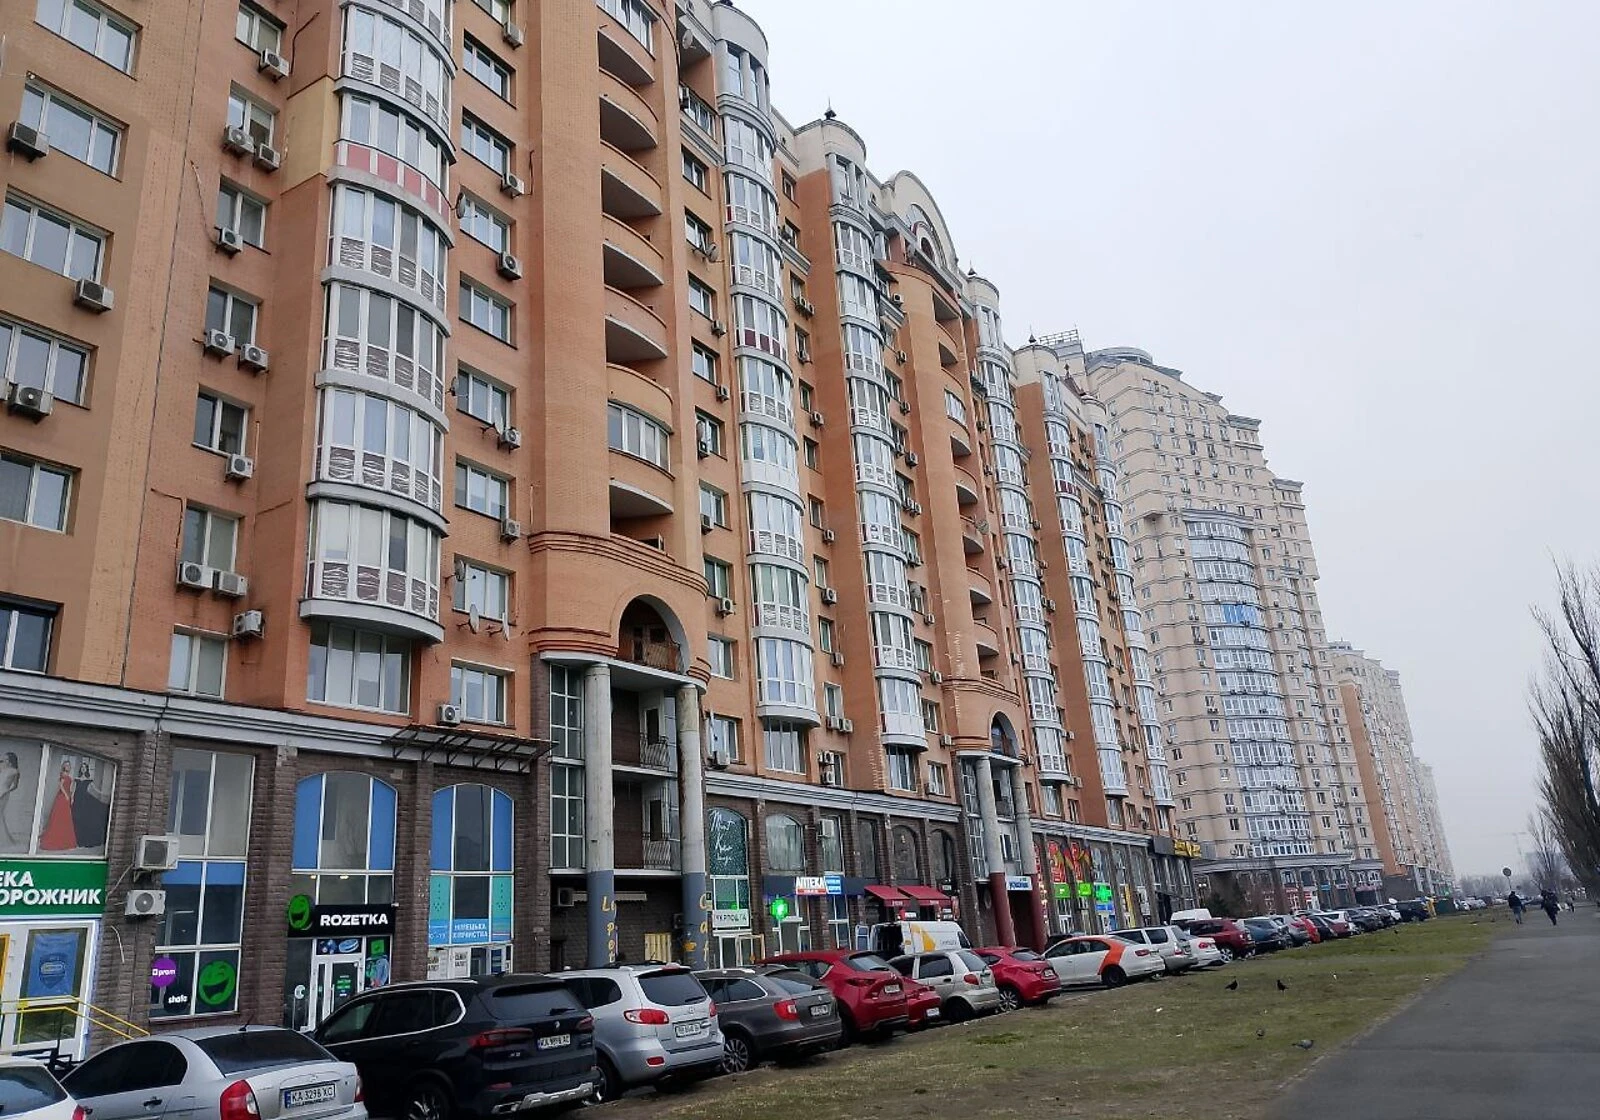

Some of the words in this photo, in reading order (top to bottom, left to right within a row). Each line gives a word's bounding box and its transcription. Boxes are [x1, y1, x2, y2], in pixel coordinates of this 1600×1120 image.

[796, 876, 825, 889] АПТЕКА
[320, 914, 389, 926] ROZETKA
[158, 969, 176, 977] prom
